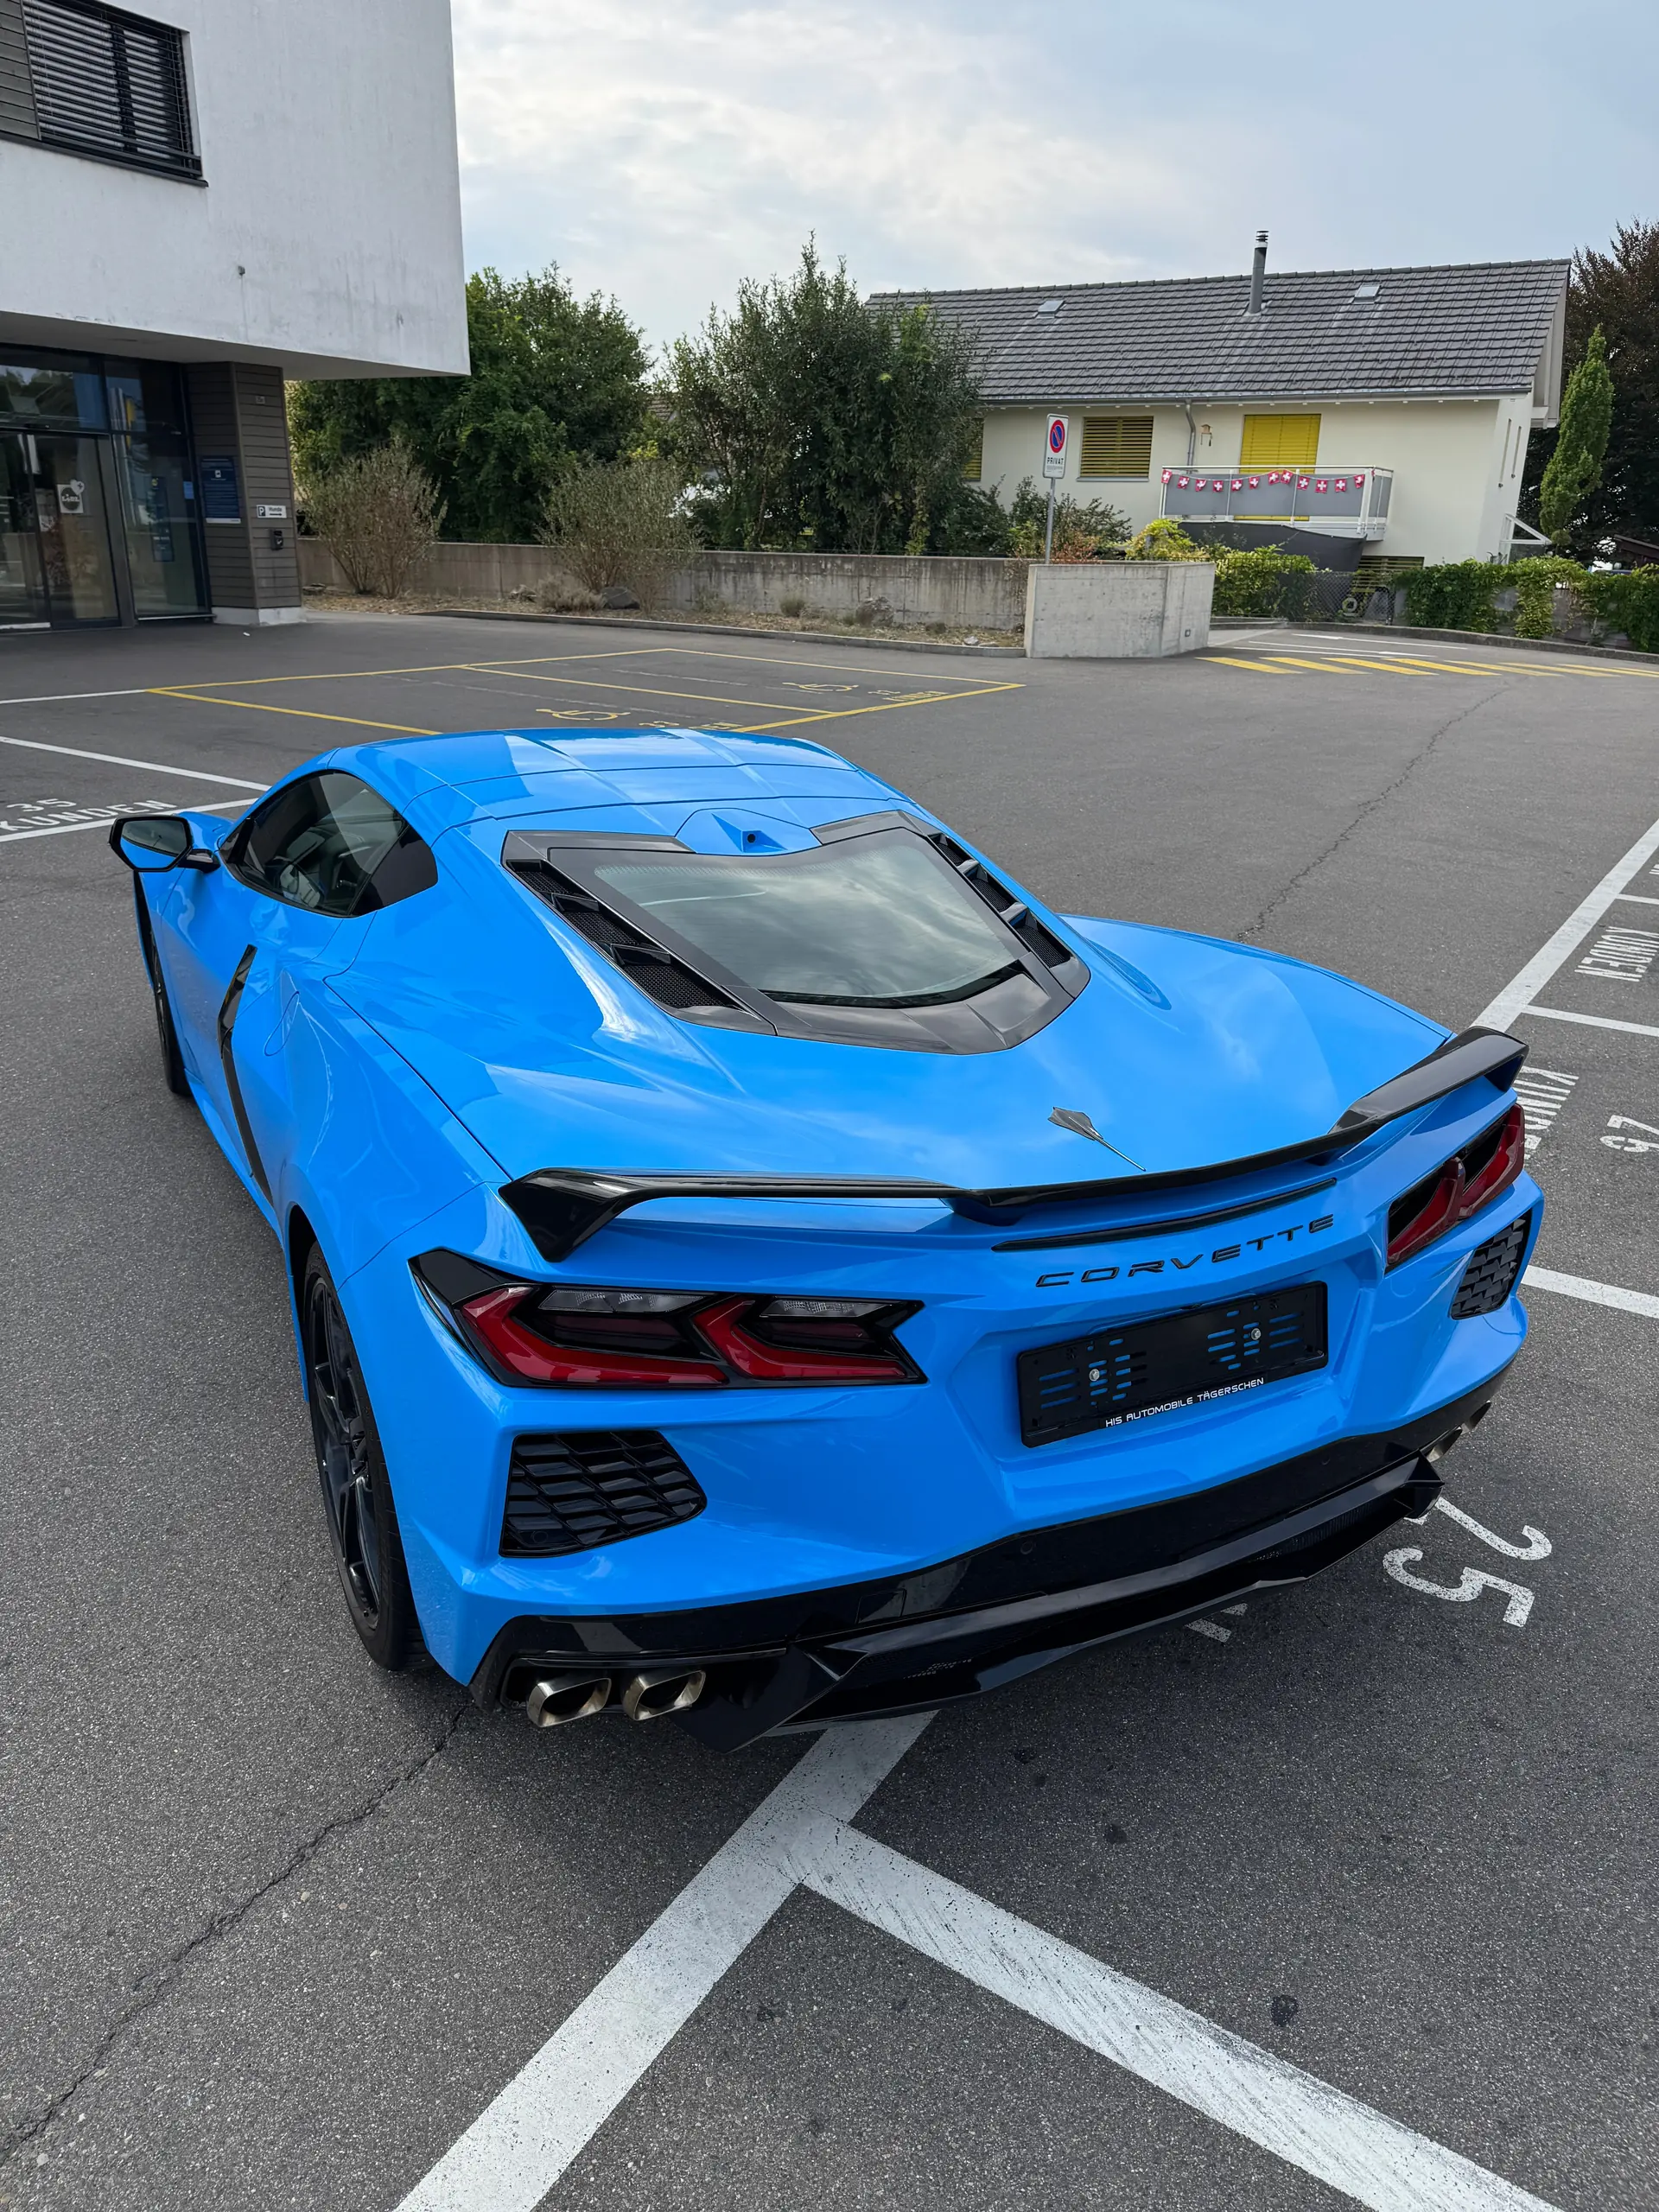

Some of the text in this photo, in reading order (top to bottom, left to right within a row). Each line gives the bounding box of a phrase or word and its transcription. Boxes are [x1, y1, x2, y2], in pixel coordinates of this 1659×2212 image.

[0, 799, 177, 831] KUNDEN
[6, 798, 77, 812] 35
[1574, 926, 1659, 982] KUNDEN
[1035, 1213, 1334, 1287] CORVETTE
[1105, 1377, 1264, 1427] HIS AUTOMOBILE TÄGERSCHEN
[1382, 1497, 1553, 1627] 25
